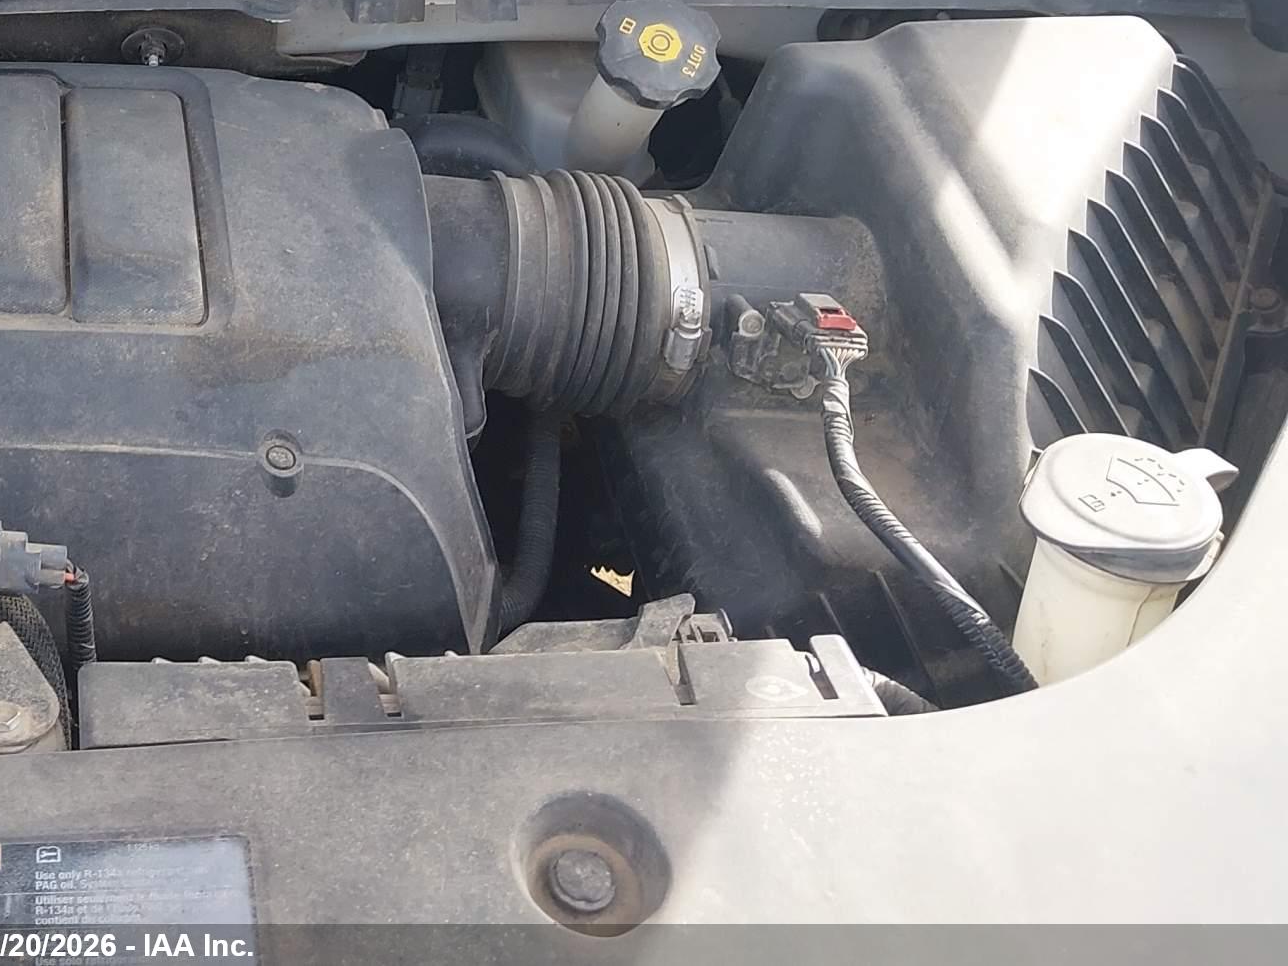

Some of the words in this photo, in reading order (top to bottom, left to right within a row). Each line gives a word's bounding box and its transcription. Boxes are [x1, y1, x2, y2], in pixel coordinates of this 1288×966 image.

[35, 870, 56, 880] Use
[58, 869, 81, 881] only
[35, 880, 57, 890] PAG
